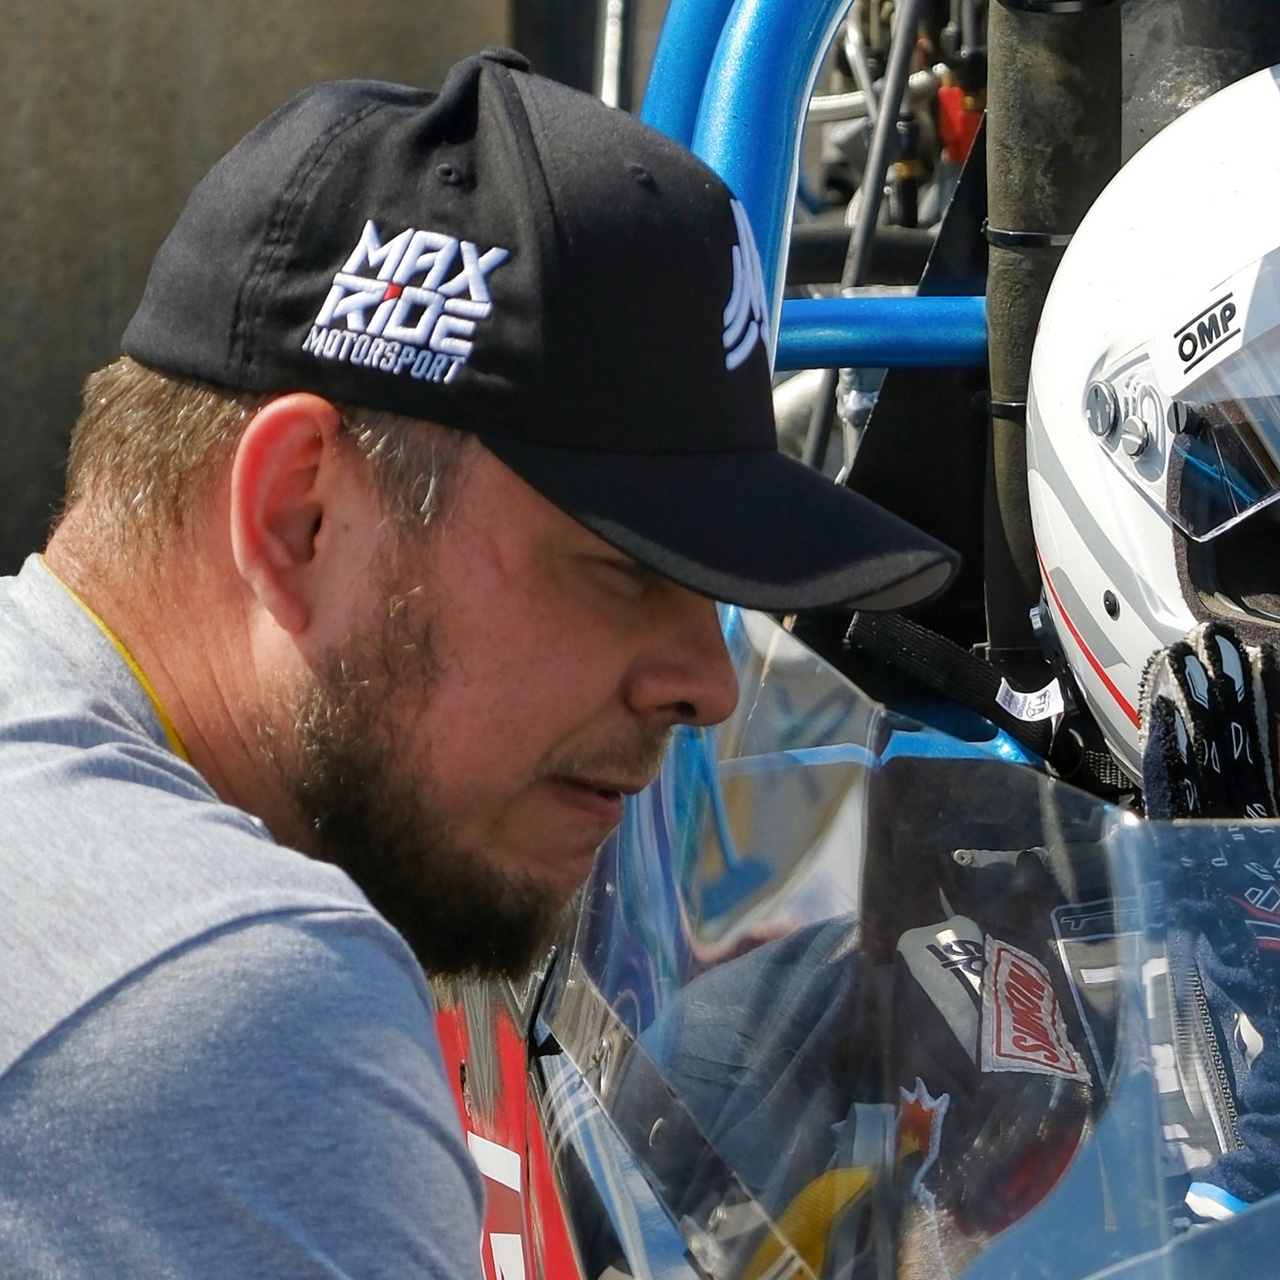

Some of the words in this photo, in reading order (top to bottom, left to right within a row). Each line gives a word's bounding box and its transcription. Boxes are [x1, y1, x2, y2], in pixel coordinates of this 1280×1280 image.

[341, 219, 510, 303] MAX
[314, 272, 493, 357] RIDE
[1177, 302, 1237, 363] OMP
[302, 324, 467, 385] MOTORSPORT
